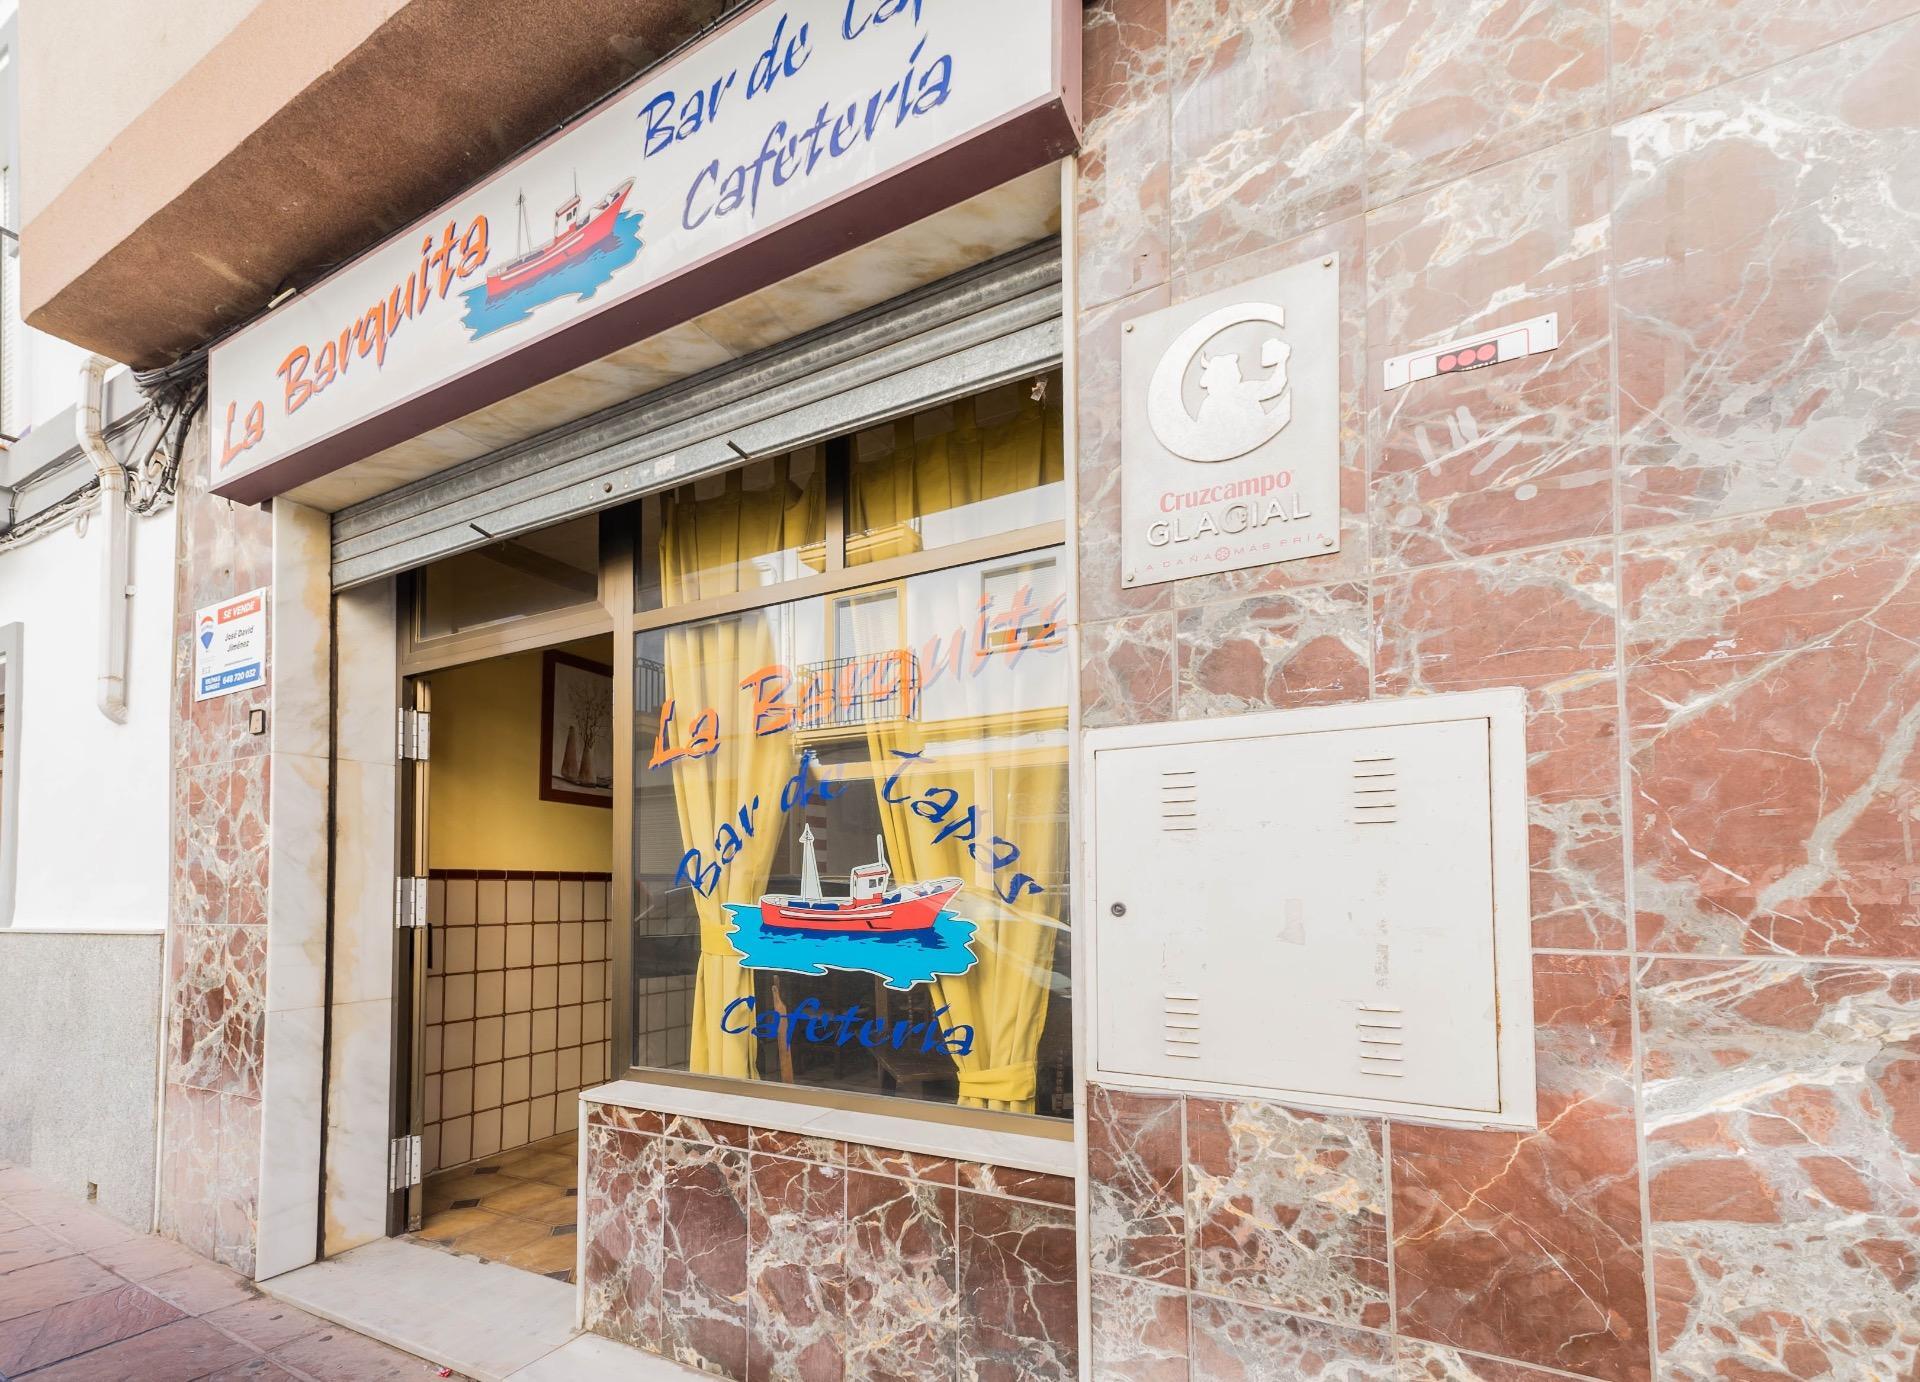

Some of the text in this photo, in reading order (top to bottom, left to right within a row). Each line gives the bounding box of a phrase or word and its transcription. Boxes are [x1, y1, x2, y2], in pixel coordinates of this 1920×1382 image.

[637, 69, 737, 160] Bar
[745, 12, 812, 101] de
[682, 31, 953, 231] Cafetería
[220, 214, 490, 471] La Barquita
[1146, 493, 1312, 547] GLACIAL
[1159, 469, 1292, 513] Cruzcampo
[223, 600, 256, 620] SE VENDE
[648, 699, 721, 770] La
[673, 748, 1045, 905] Bar de Tapas
[720, 995, 975, 1057] Cafetería
